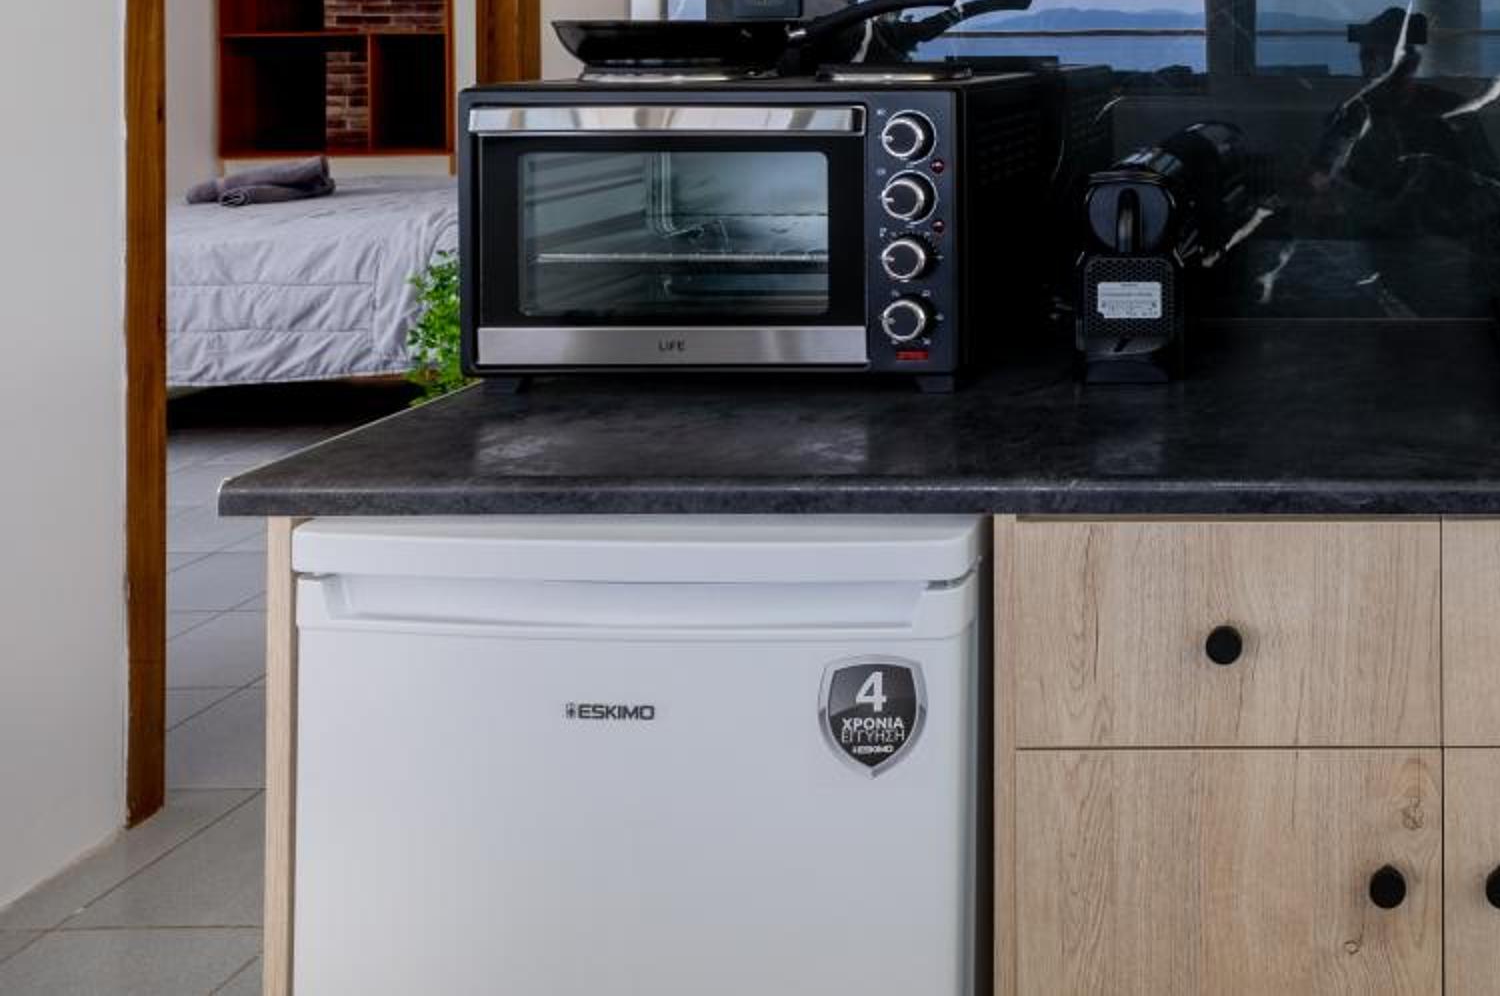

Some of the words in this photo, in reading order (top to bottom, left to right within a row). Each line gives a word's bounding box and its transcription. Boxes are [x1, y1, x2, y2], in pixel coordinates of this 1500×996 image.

[658, 339, 686, 352] LIFE
[855, 671, 887, 713] 4
[578, 703, 655, 721] ESKIMO
[841, 716, 904, 732] ΧΡΟΝΙΑ
